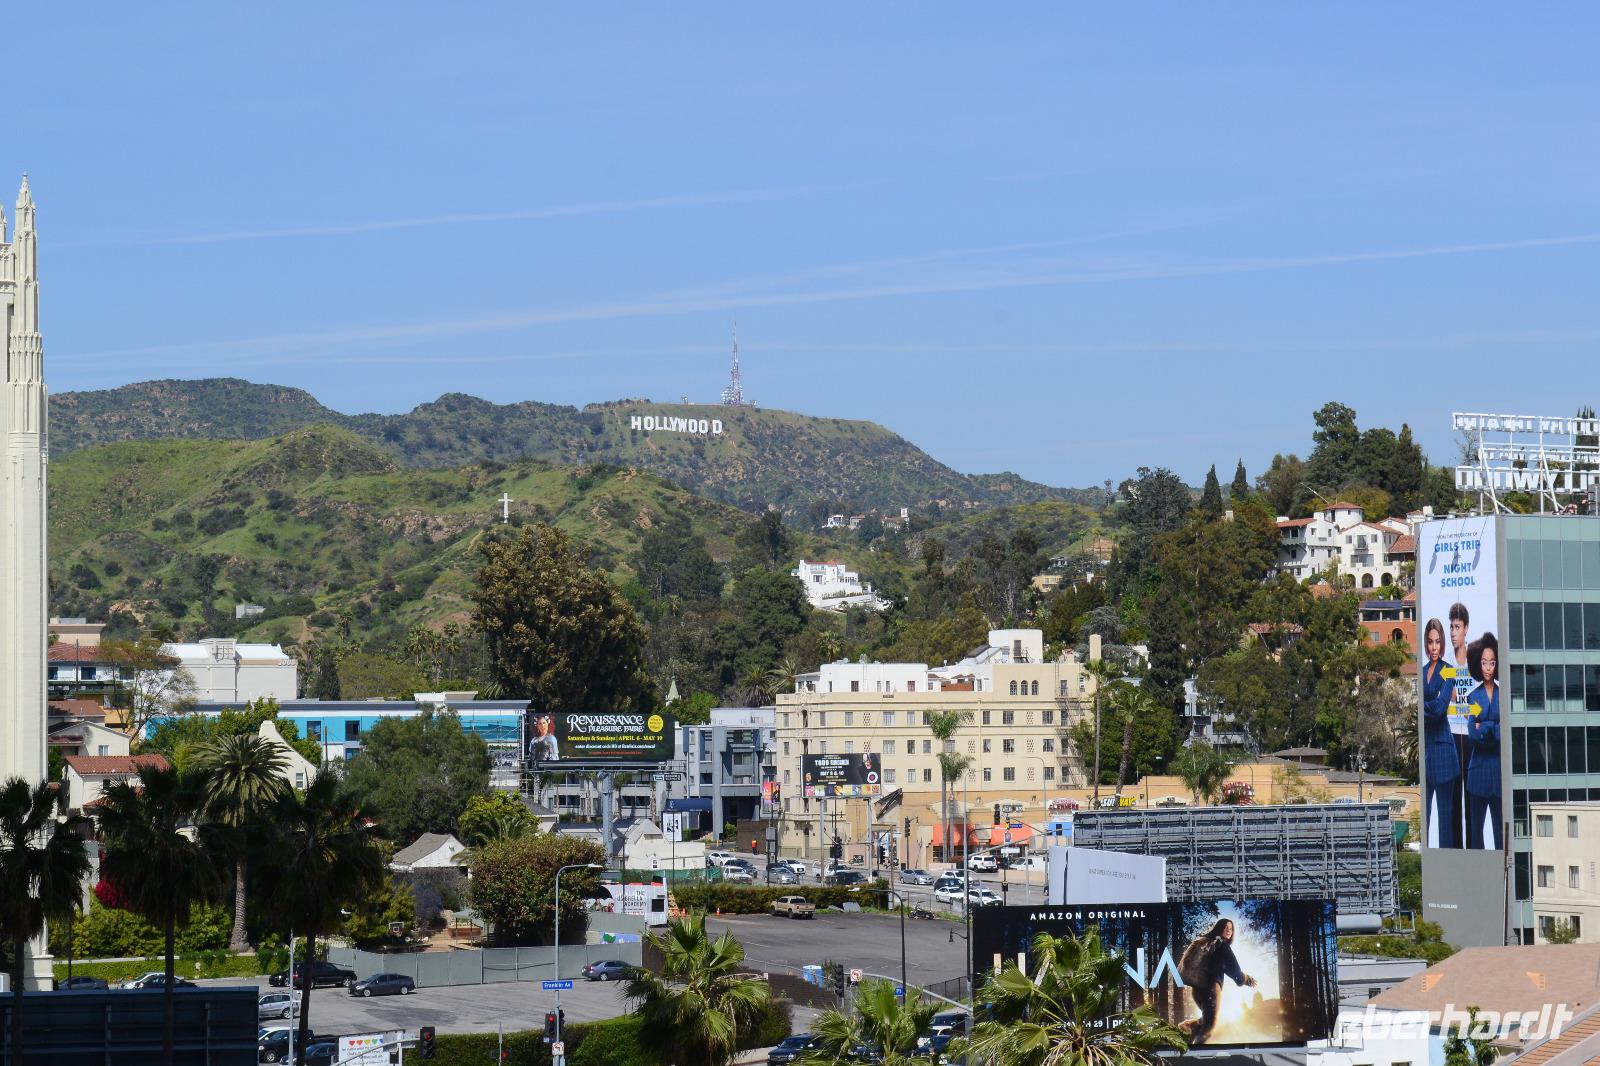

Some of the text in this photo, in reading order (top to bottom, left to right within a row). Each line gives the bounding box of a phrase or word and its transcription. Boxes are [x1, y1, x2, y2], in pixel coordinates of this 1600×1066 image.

[631, 415, 723, 434] HOLLYWOOD
[1434, 539, 1481, 553] GIRLS TRIP
[1443, 562, 1472, 574] NIGHT
[1441, 575, 1476, 588] SCHOOL
[1455, 668, 1469, 677] SHE
[1452, 678, 1473, 687] WOKE
[1457, 687, 1468, 696] UP
[1455, 696, 1470, 704] LIKE
[1455, 705, 1470, 714] THIS
[566, 713, 645, 732] RENAISSANCE
[588, 725, 622, 733] PLEASURE
[1030, 910, 1147, 921] AMAZON ORIGINAL
[1093, 1019, 1104, 1028] 29
